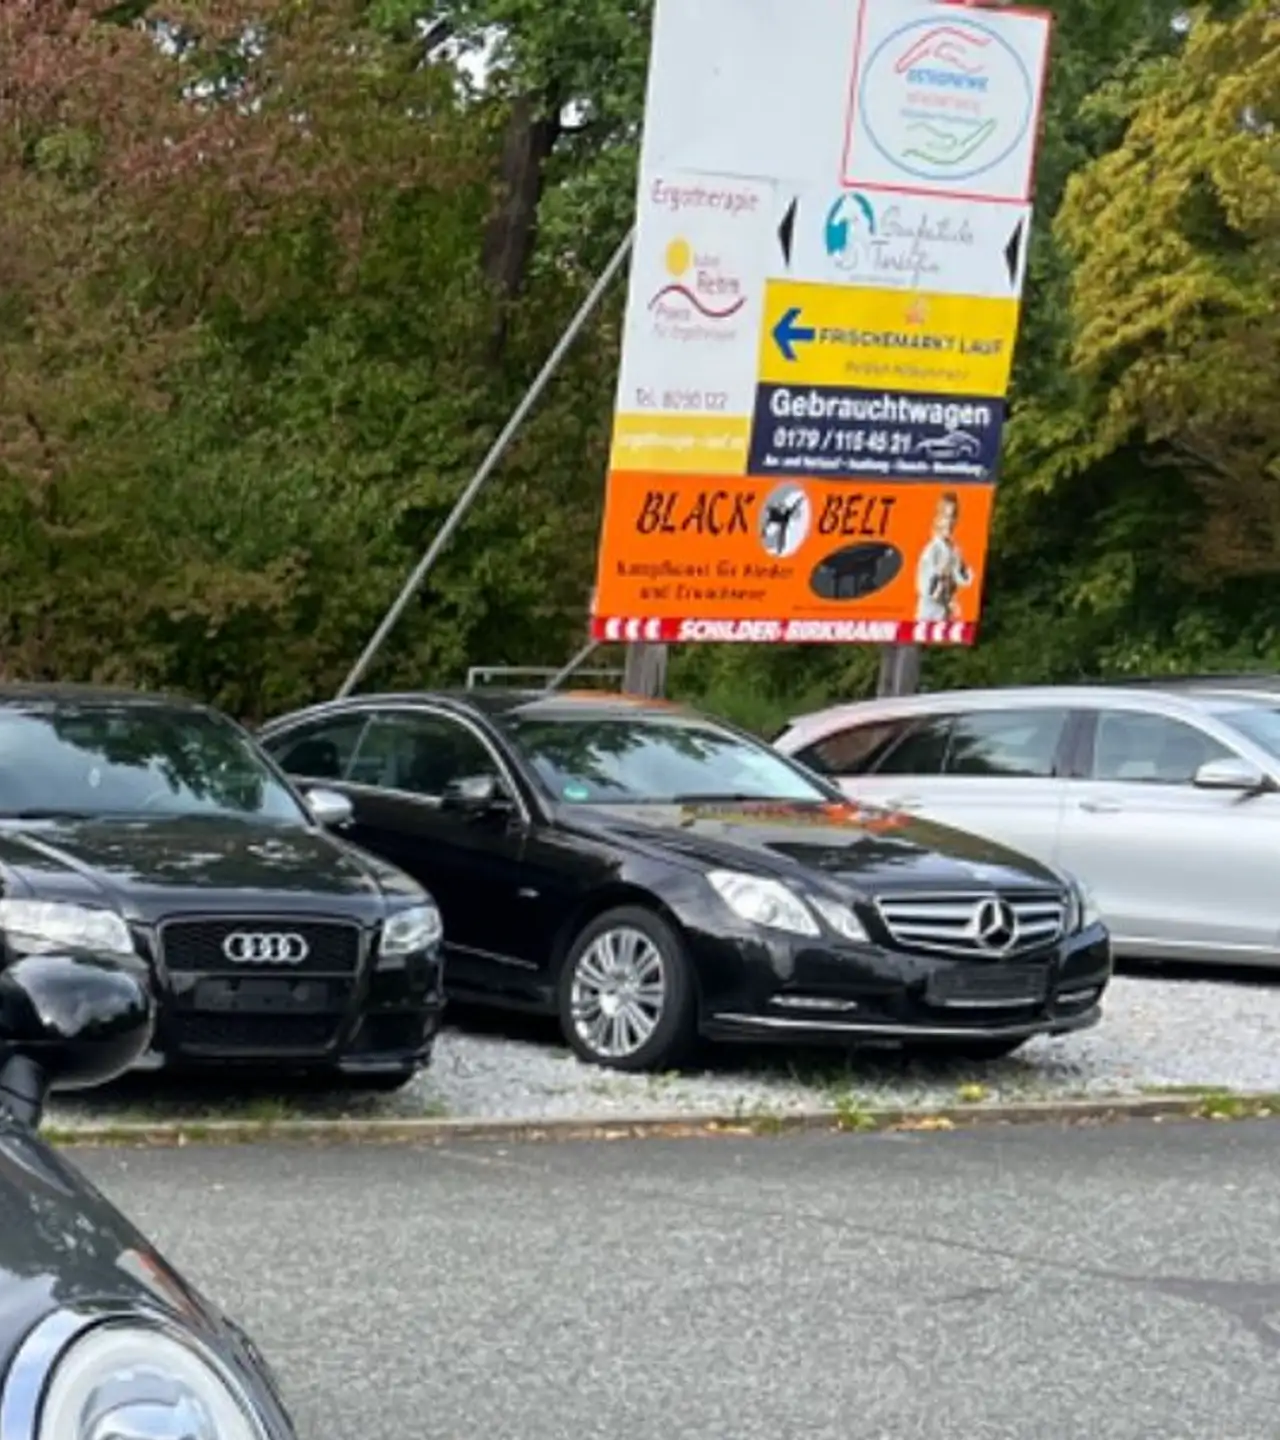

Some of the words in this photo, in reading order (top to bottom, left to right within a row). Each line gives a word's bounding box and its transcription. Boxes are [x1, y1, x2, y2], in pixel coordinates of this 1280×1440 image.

[651, 179, 760, 216] Ergotherapie
[770, 389, 991, 430] Gebrauchtwagen
[774, 425, 820, 448] 0179
[636, 491, 756, 536] BLACK
[818, 494, 895, 536] BELT
